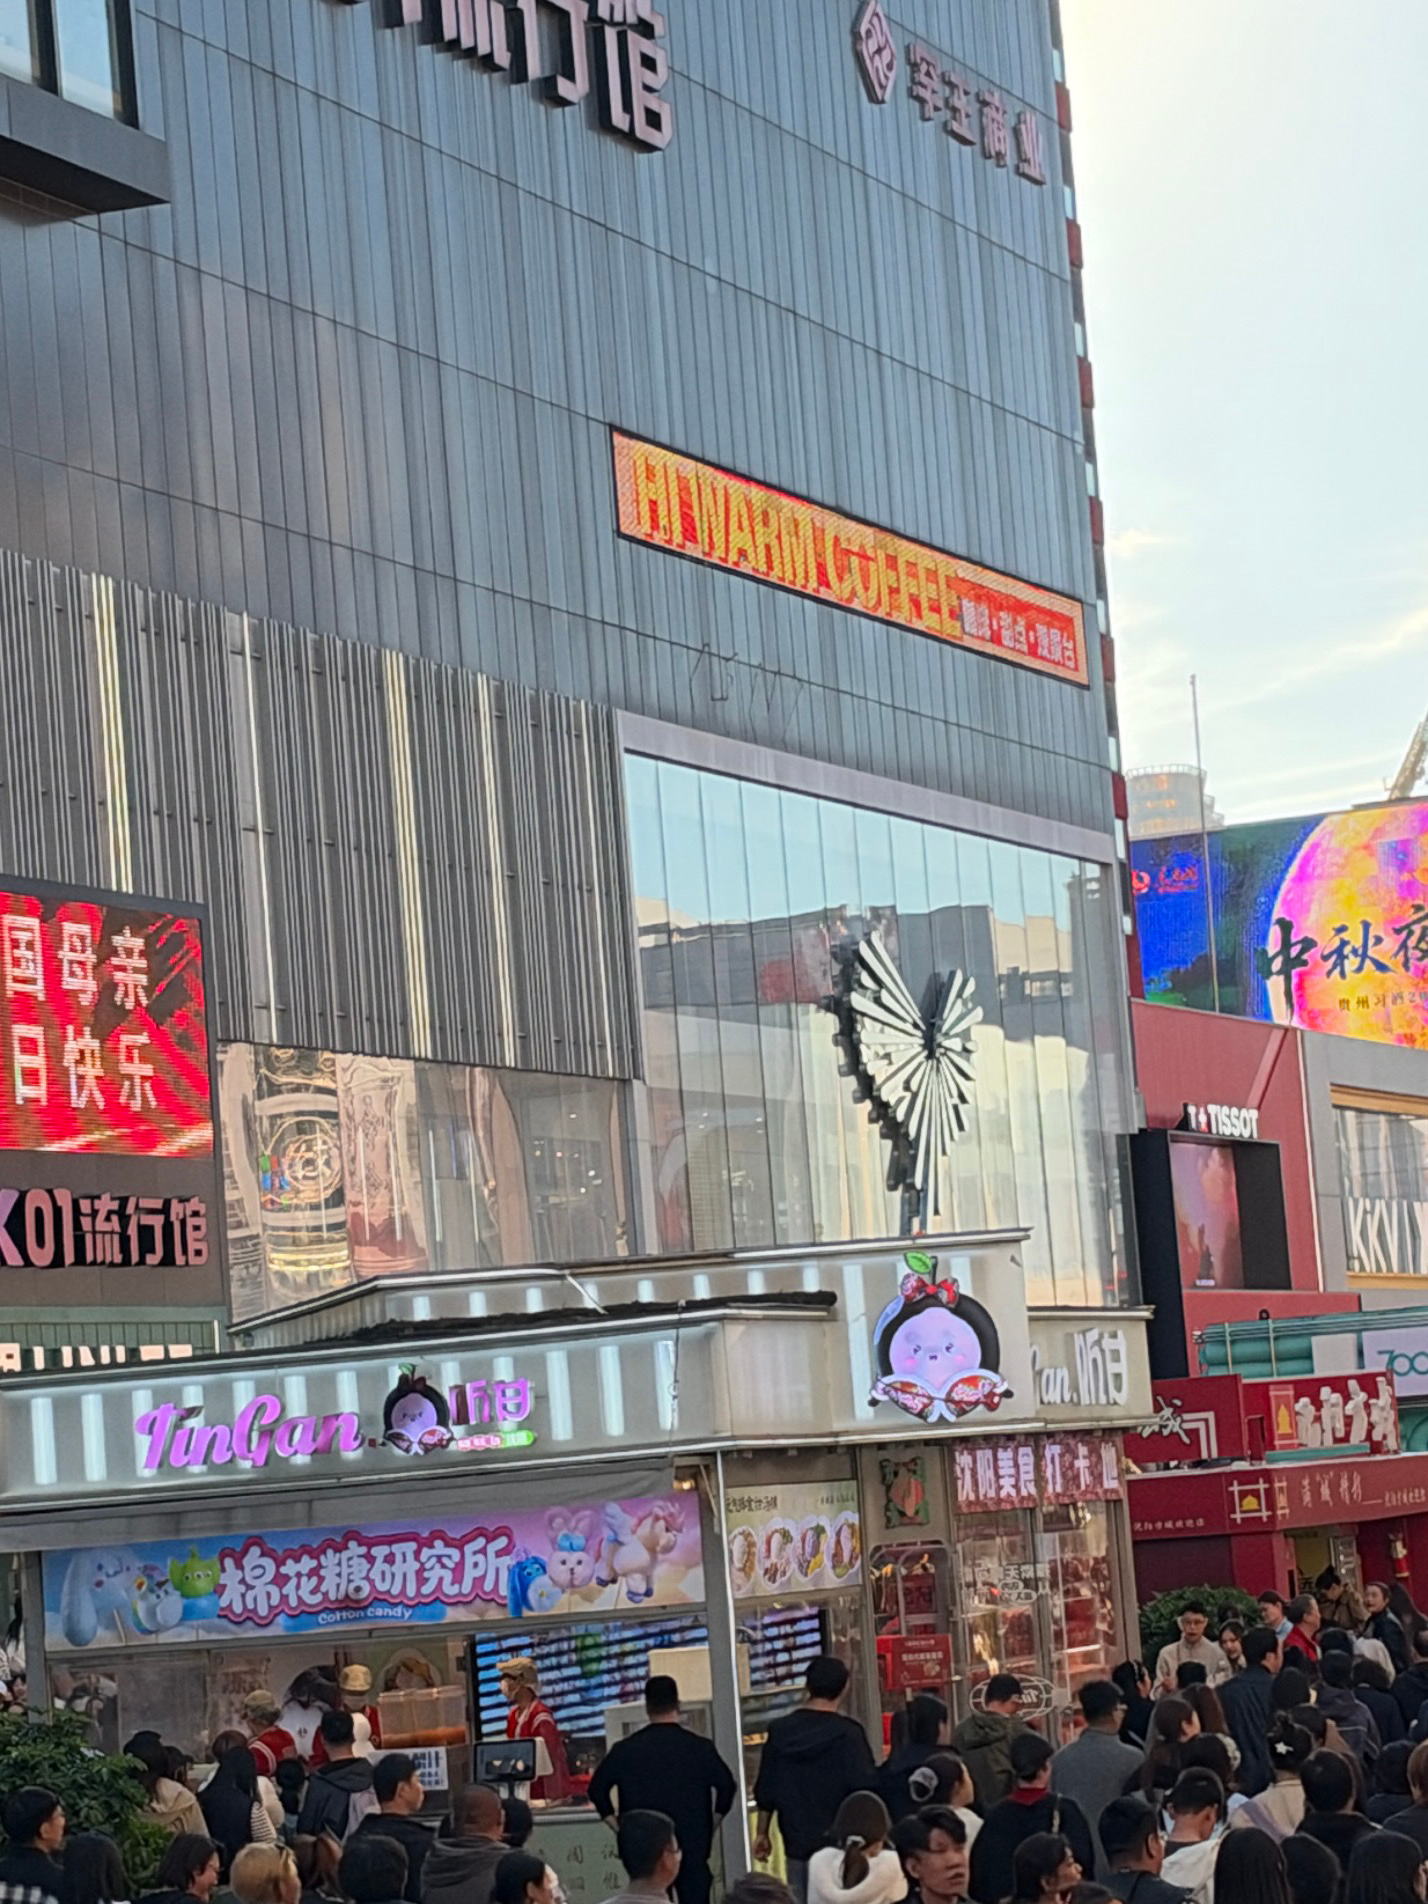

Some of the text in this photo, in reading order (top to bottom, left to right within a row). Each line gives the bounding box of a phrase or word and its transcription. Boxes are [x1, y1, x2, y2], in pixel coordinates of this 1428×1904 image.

[690, 467, 819, 592] WARM
[825, 519, 964, 641] COFFEE
[1207, 1104, 1259, 1139] TISSOT
[218, 1534, 514, 1619] 棉花糖研究所
[317, 1604, 413, 1627] Cotton candy
